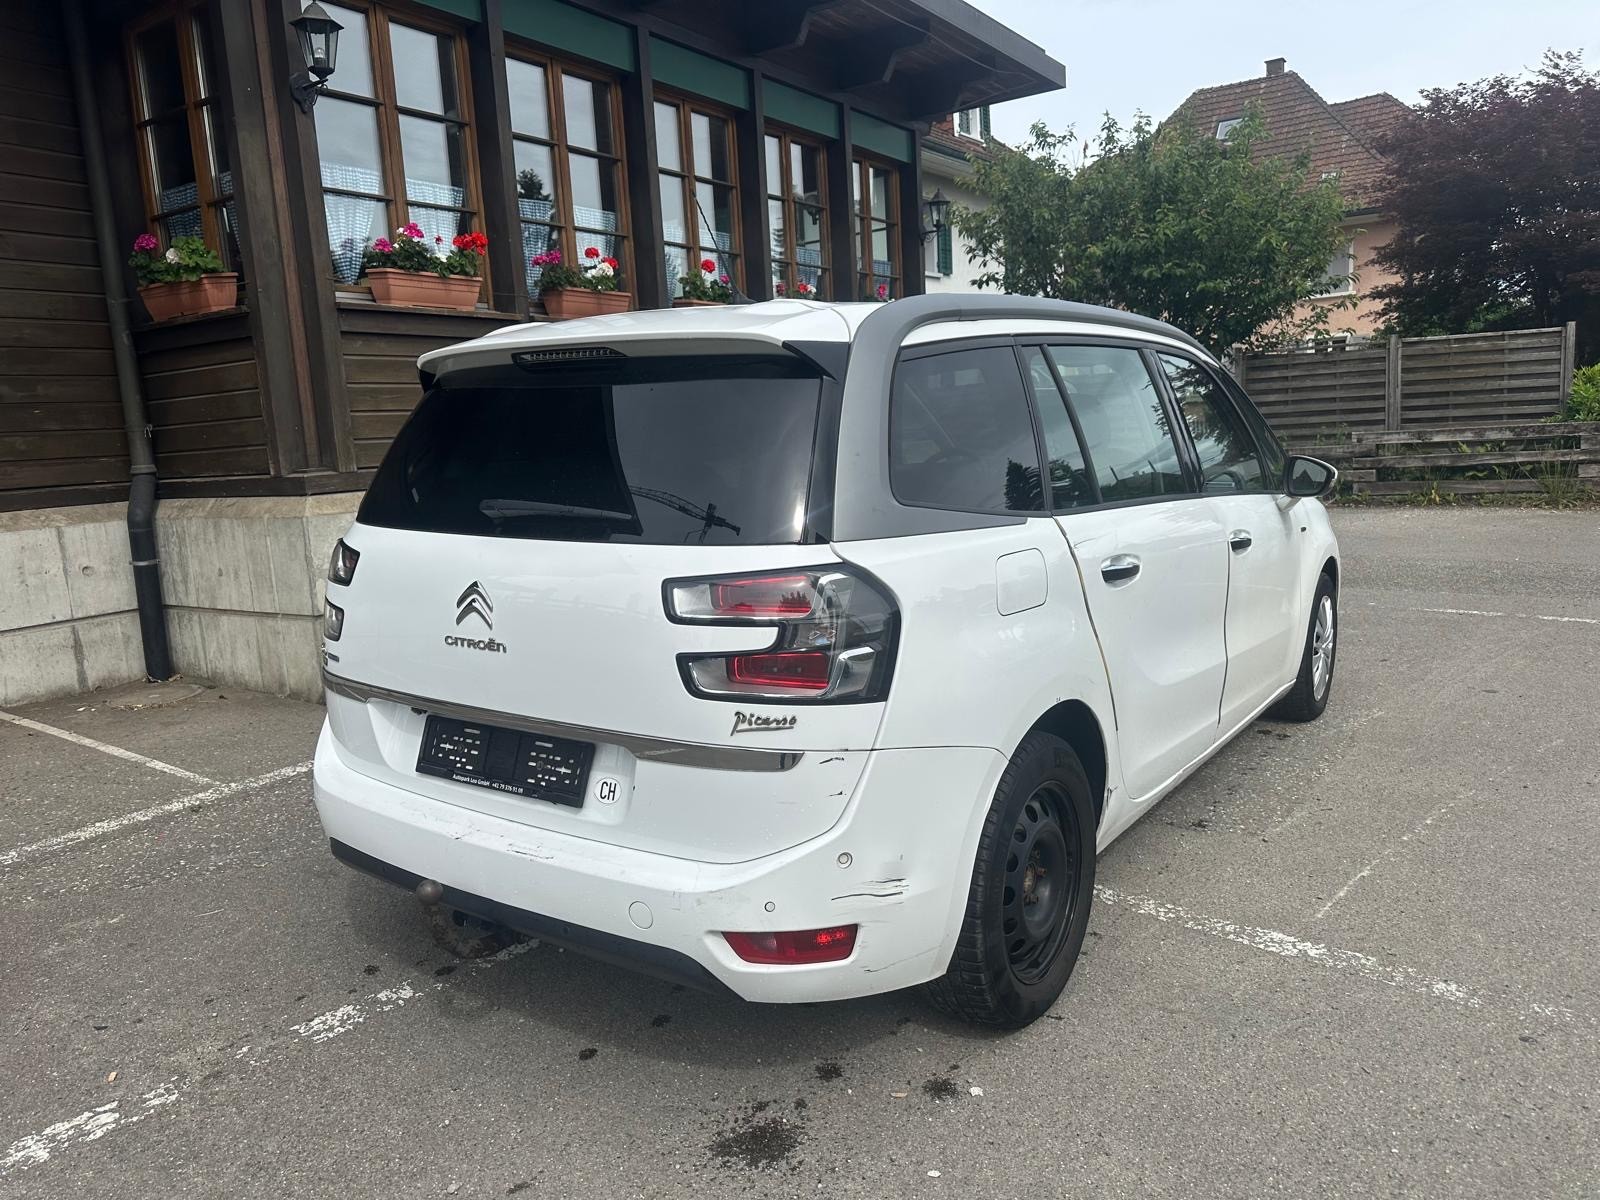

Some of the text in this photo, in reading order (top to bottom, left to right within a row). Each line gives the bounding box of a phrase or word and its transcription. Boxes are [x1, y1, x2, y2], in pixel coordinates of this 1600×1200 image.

[730, 711, 797, 736] Picasso
[452, 773, 470, 782] Autopark
[478, 778, 491, 786] GmbH
[600, 781, 616, 801] CH
